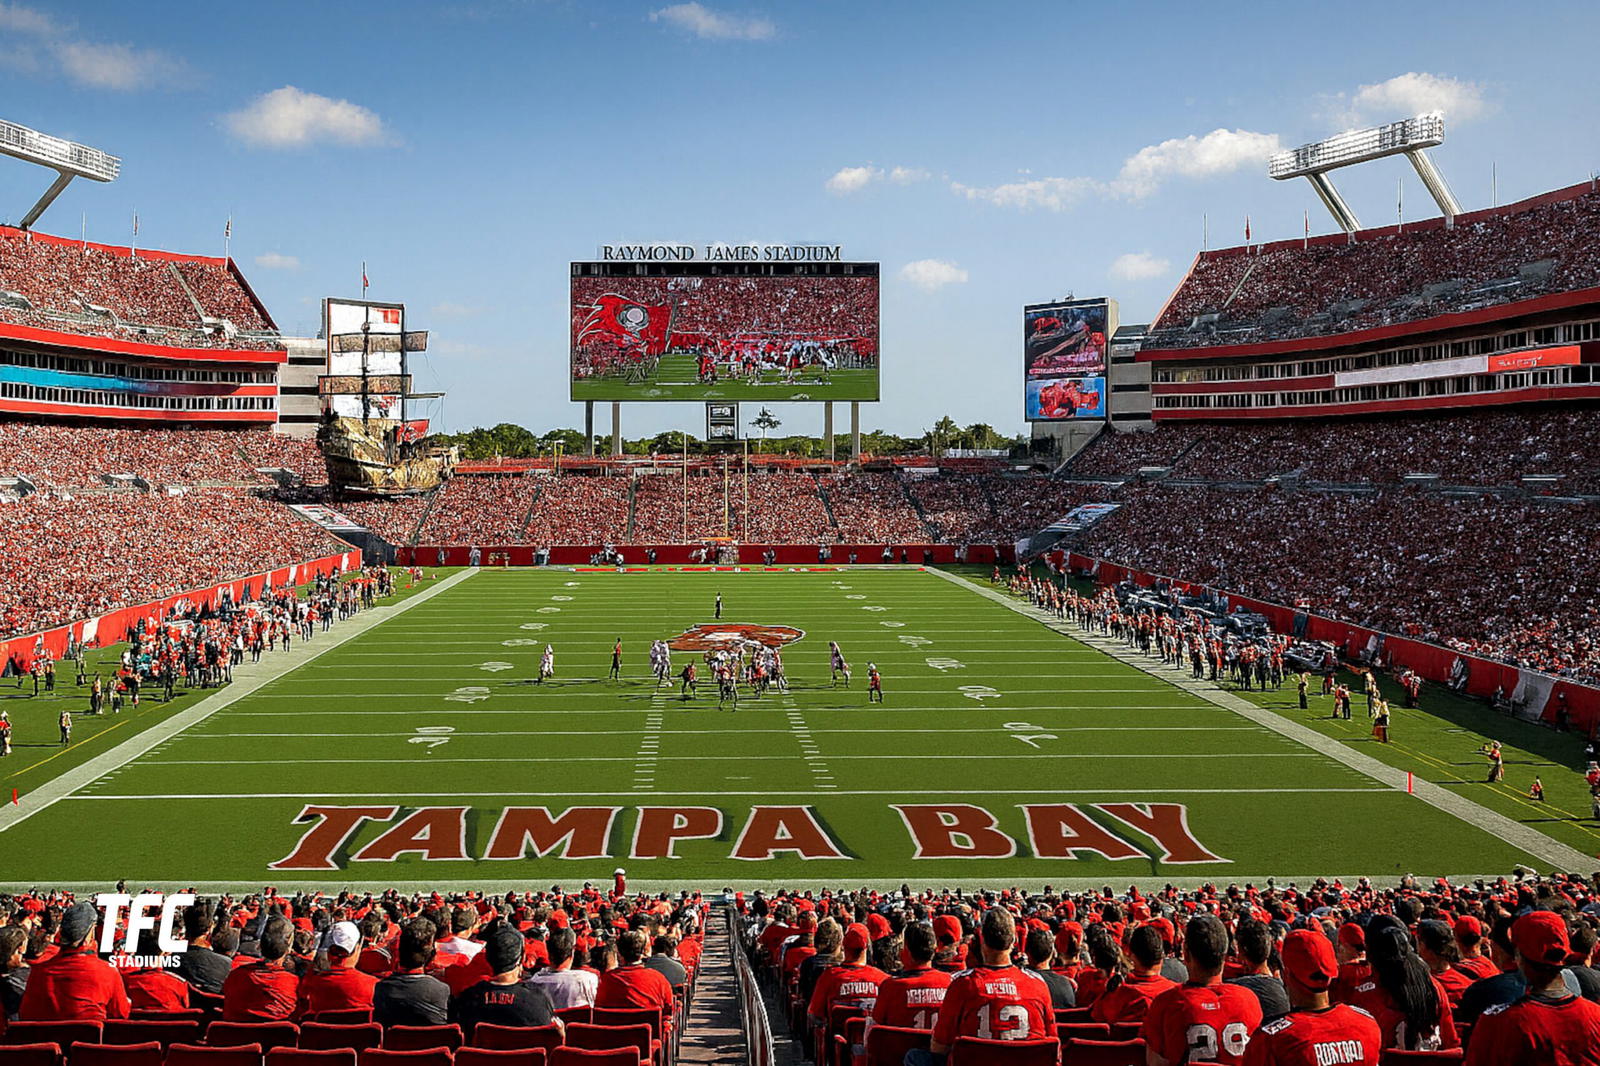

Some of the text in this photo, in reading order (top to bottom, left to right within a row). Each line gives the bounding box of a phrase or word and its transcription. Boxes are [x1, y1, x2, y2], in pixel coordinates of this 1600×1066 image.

[602, 245, 841, 261] RAYMOND JAMES STADIUM
[267, 803, 1234, 871] TAMPA BAY
